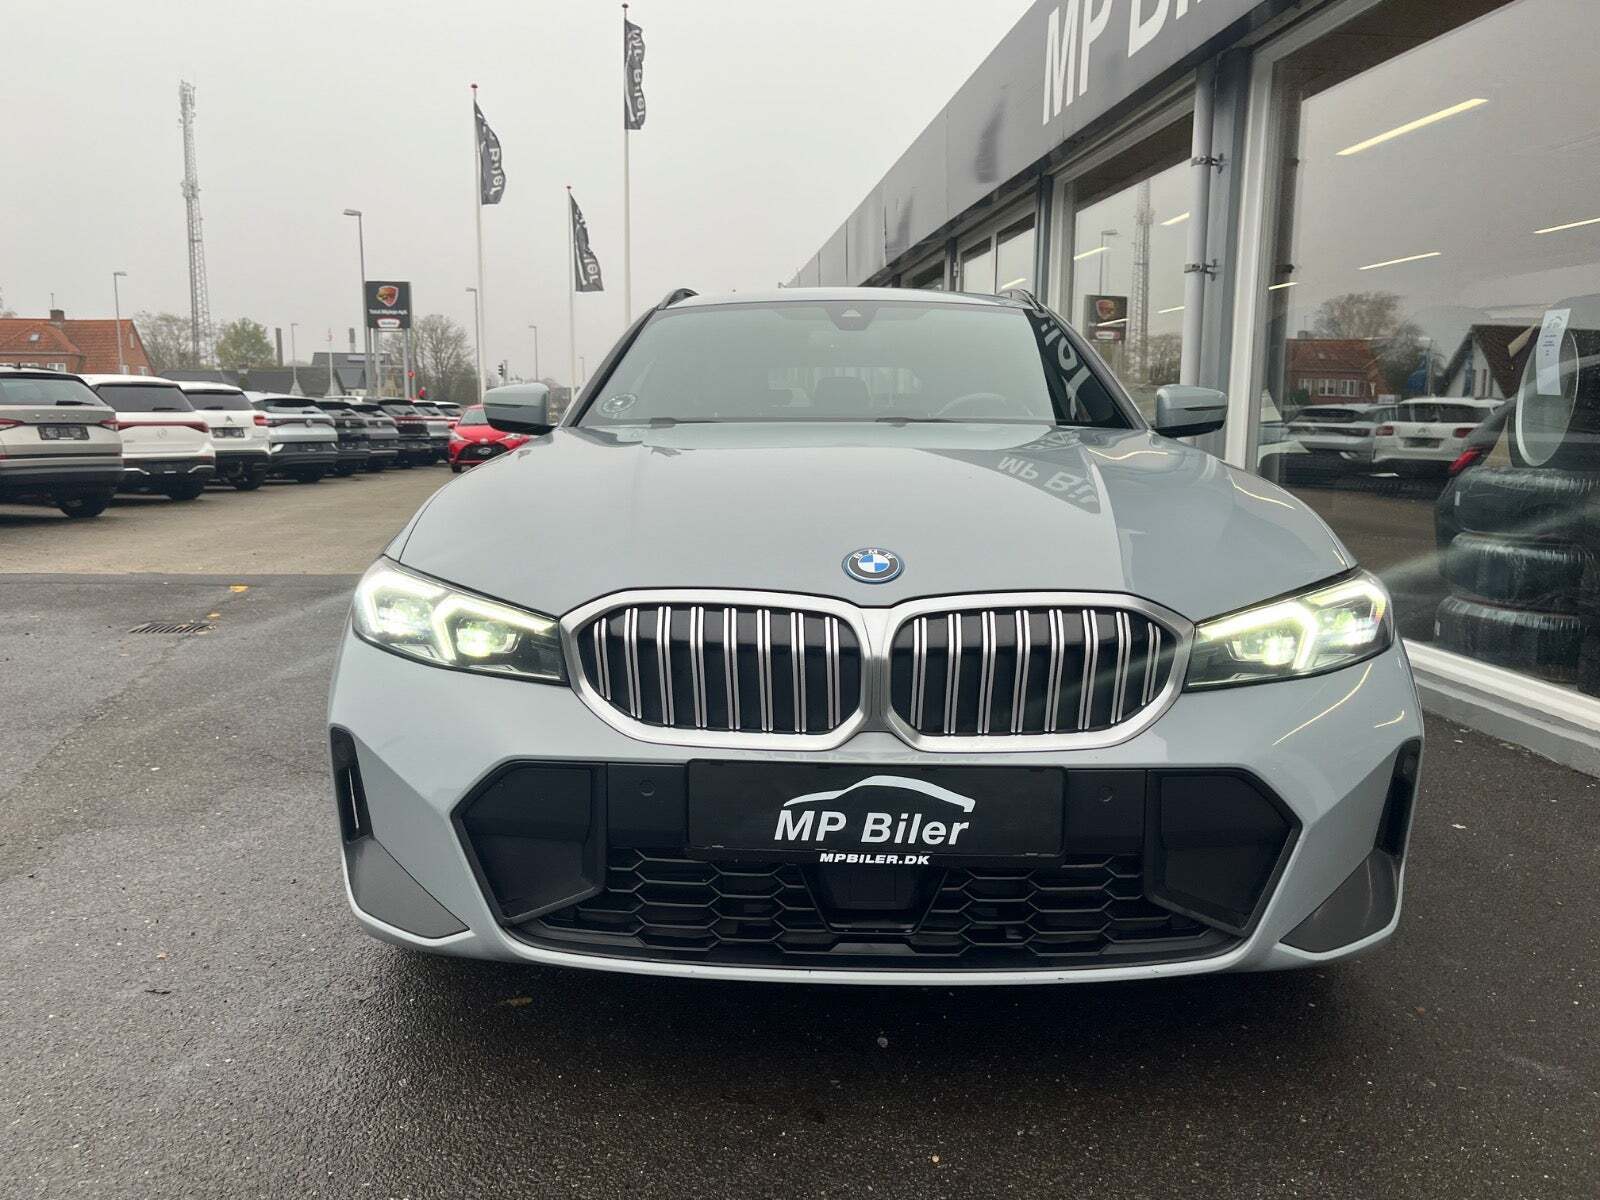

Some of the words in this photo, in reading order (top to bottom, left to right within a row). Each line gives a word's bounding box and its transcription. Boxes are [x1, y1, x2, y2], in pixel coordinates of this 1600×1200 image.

[774, 809, 847, 842] MP
[861, 812, 970, 846] Biler
[819, 852, 931, 866] MPBILER.DK
